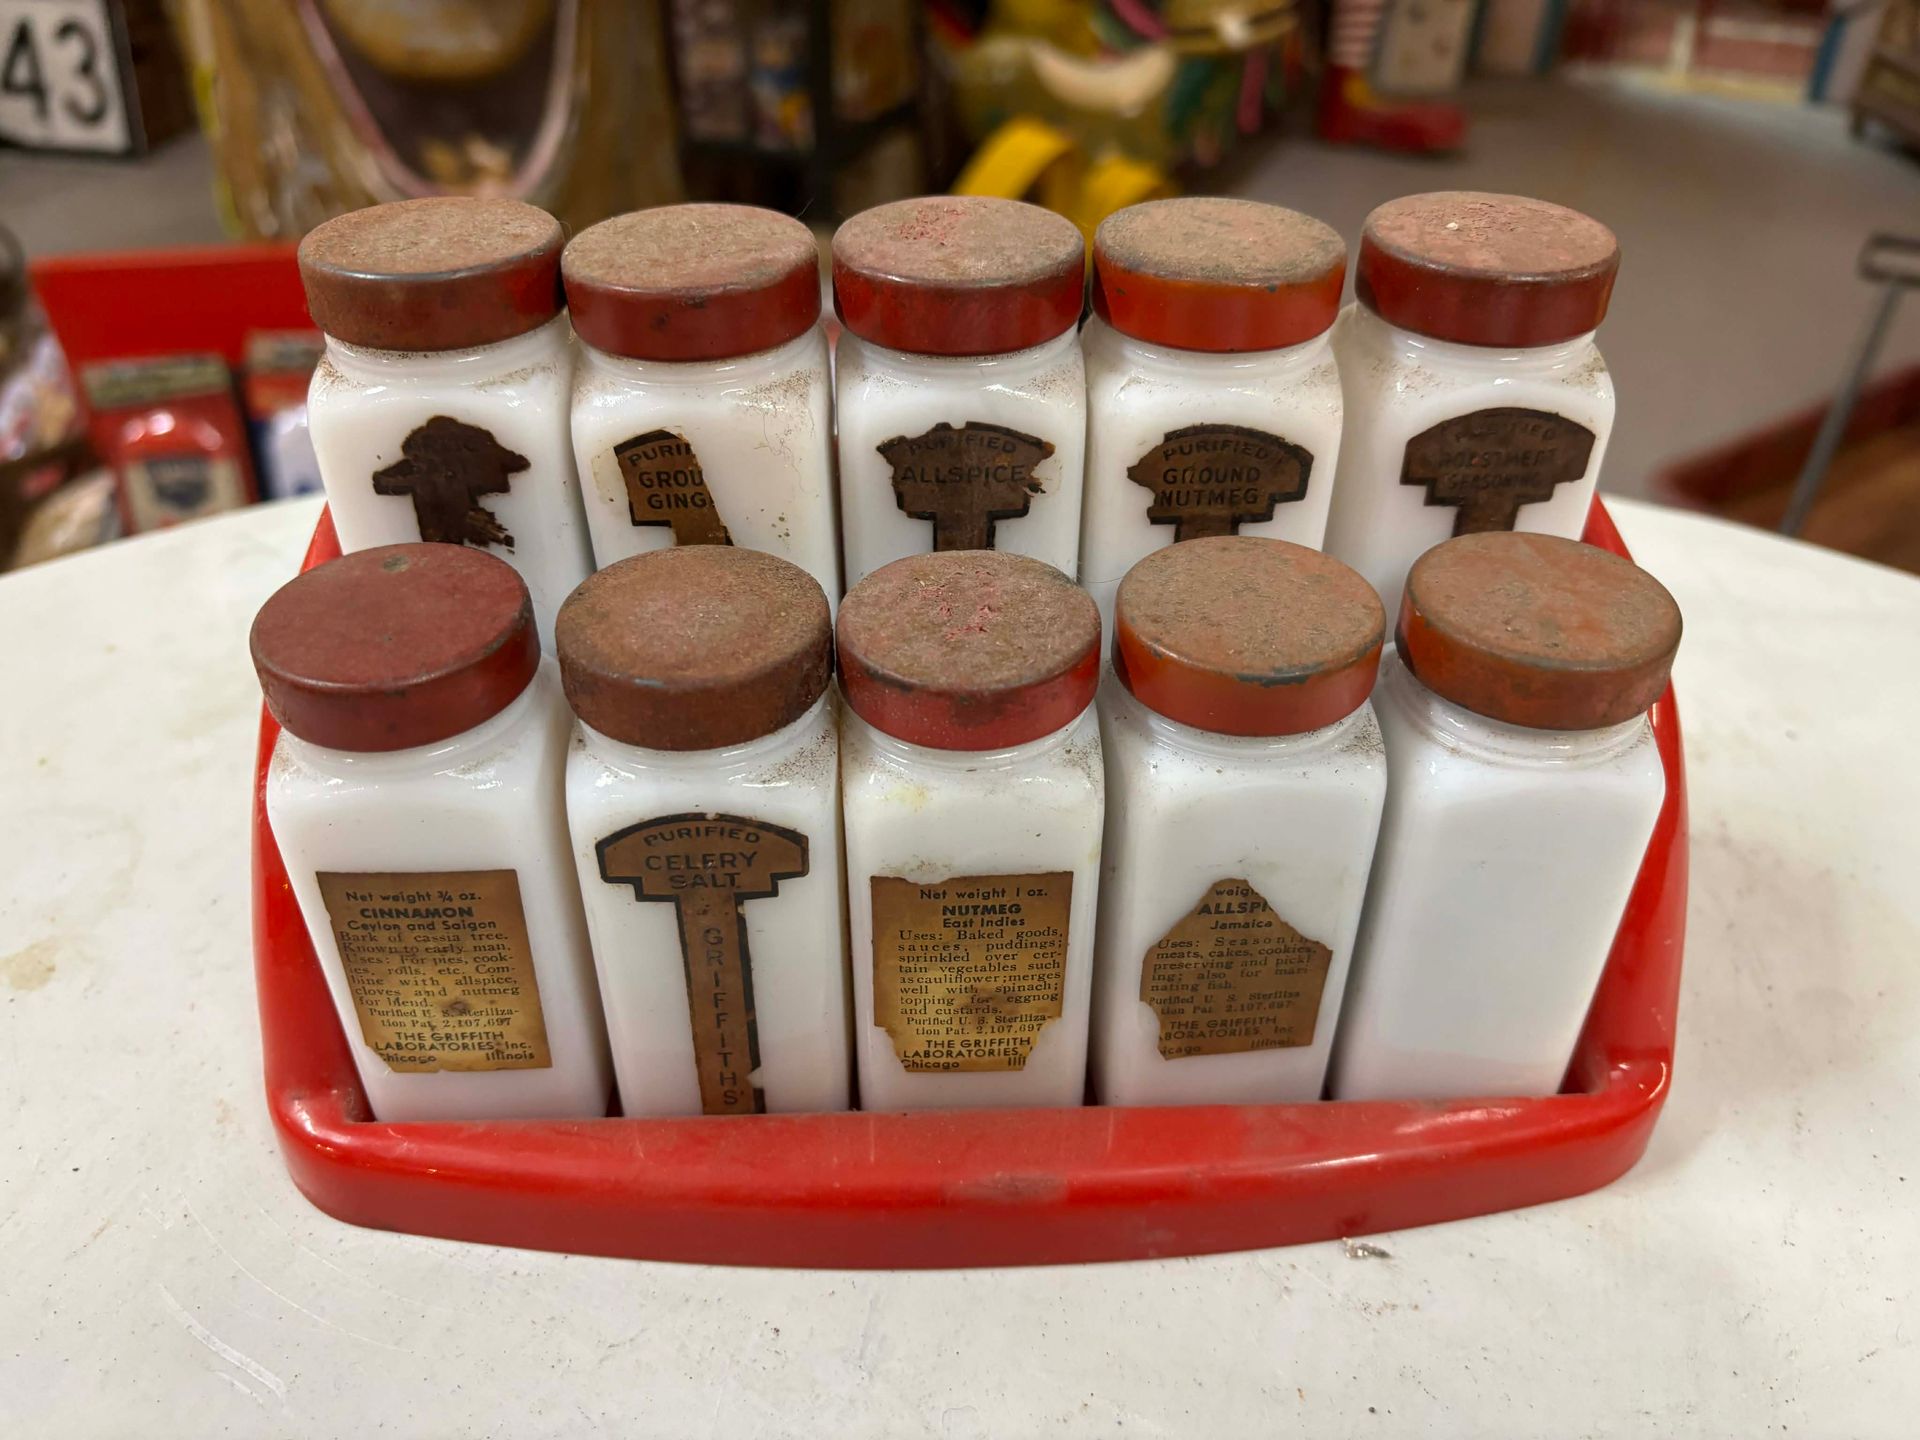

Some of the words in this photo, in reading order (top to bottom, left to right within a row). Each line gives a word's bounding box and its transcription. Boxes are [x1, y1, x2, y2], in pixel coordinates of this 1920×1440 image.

[2, 18, 108, 126] 43
[1163, 439, 1268, 462] PURIFIED
[901, 465, 1026, 484] ALLSPICE
[1162, 466, 1261, 485] GROUND
[1159, 488, 1259, 508] NUTMEG
[643, 826, 760, 847] PURIFIED
[645, 851, 758, 871] CELERY
[346, 891, 373, 902] Net
[379, 891, 432, 904] weight
[920, 888, 947, 900] Net
[956, 887, 1007, 901] weight
[1027, 888, 1048, 897] oz.
[359, 906, 474, 919] CINNAMON
[942, 903, 1022, 916] NUTMEG
[1197, 901, 1273, 915] ALLSPI
[347, 919, 401, 932] Ceylon
[407, 920, 436, 931] and
[442, 920, 497, 932] Saigon
[943, 917, 974, 928] East
[981, 916, 1025, 927] Indies
[1210, 919, 1273, 930] Jamaica
[339, 930, 378, 942] Bark
[414, 933, 461, 942] cassia
[899, 930, 943, 941] Uses:
[957, 929, 1004, 940] Baked
[1016, 927, 1063, 940] goods,
[343, 942, 399, 954] Known
[986, 939, 1063, 952] puddings;
[1158, 938, 1200, 950] Uses:
[473, 952, 514, 963] cook-
[898, 952, 970, 964] sprinkled
[985, 952, 1019, 961] over
[1033, 951, 1062, 960] cer-
[475, 963, 516, 974] Com-
[899, 964, 928, 973] tain
[940, 962, 1017, 975] vegetables
[1027, 960, 1060, 971] such
[1152, 958, 1233, 973] preserving
[1240, 957, 1268, 967] and
[399, 976, 440, 986] with
[1151, 971, 1183, 983] ing;
[1197, 969, 1226, 980] also
[1240, 968, 1261, 978] for
[355, 986, 401, 996] cloves
[462, 986, 520, 996] nutmeg
[900, 985, 929, 994] well
[946, 984, 978, 994] with
[995, 982, 1059, 994] spinach;
[1150, 980, 1200, 993] nating
[358, 996, 381, 1006] for
[900, 996, 954, 1006] topping
[970, 994, 992, 1003] for
[1006, 993, 1059, 1004] eggnog
[368, 1007, 417, 1018] Purified
[900, 1005, 927, 1015] and
[935, 1005, 1003, 1015] custards.
[380, 1019, 406, 1028] tion
[906, 1016, 953, 1025] Purified
[959, 1016, 972, 1025] U.
[1168, 1020, 1200, 1030] THE
[1206, 1015, 1277, 1029] GRIFFITH
[394, 1031, 427, 1041] THE
[431, 1031, 505, 1041] GRIFFITH
[916, 1027, 940, 1036] tion
[945, 1026, 970, 1035] Pat.
[505, 1041, 532, 1050] Inc.
[925, 1039, 955, 1049] THE
[960, 1036, 1031, 1048] GRIFFITH
[485, 1049, 535, 1061] Illinois
[901, 1059, 960, 1070] Chicago
